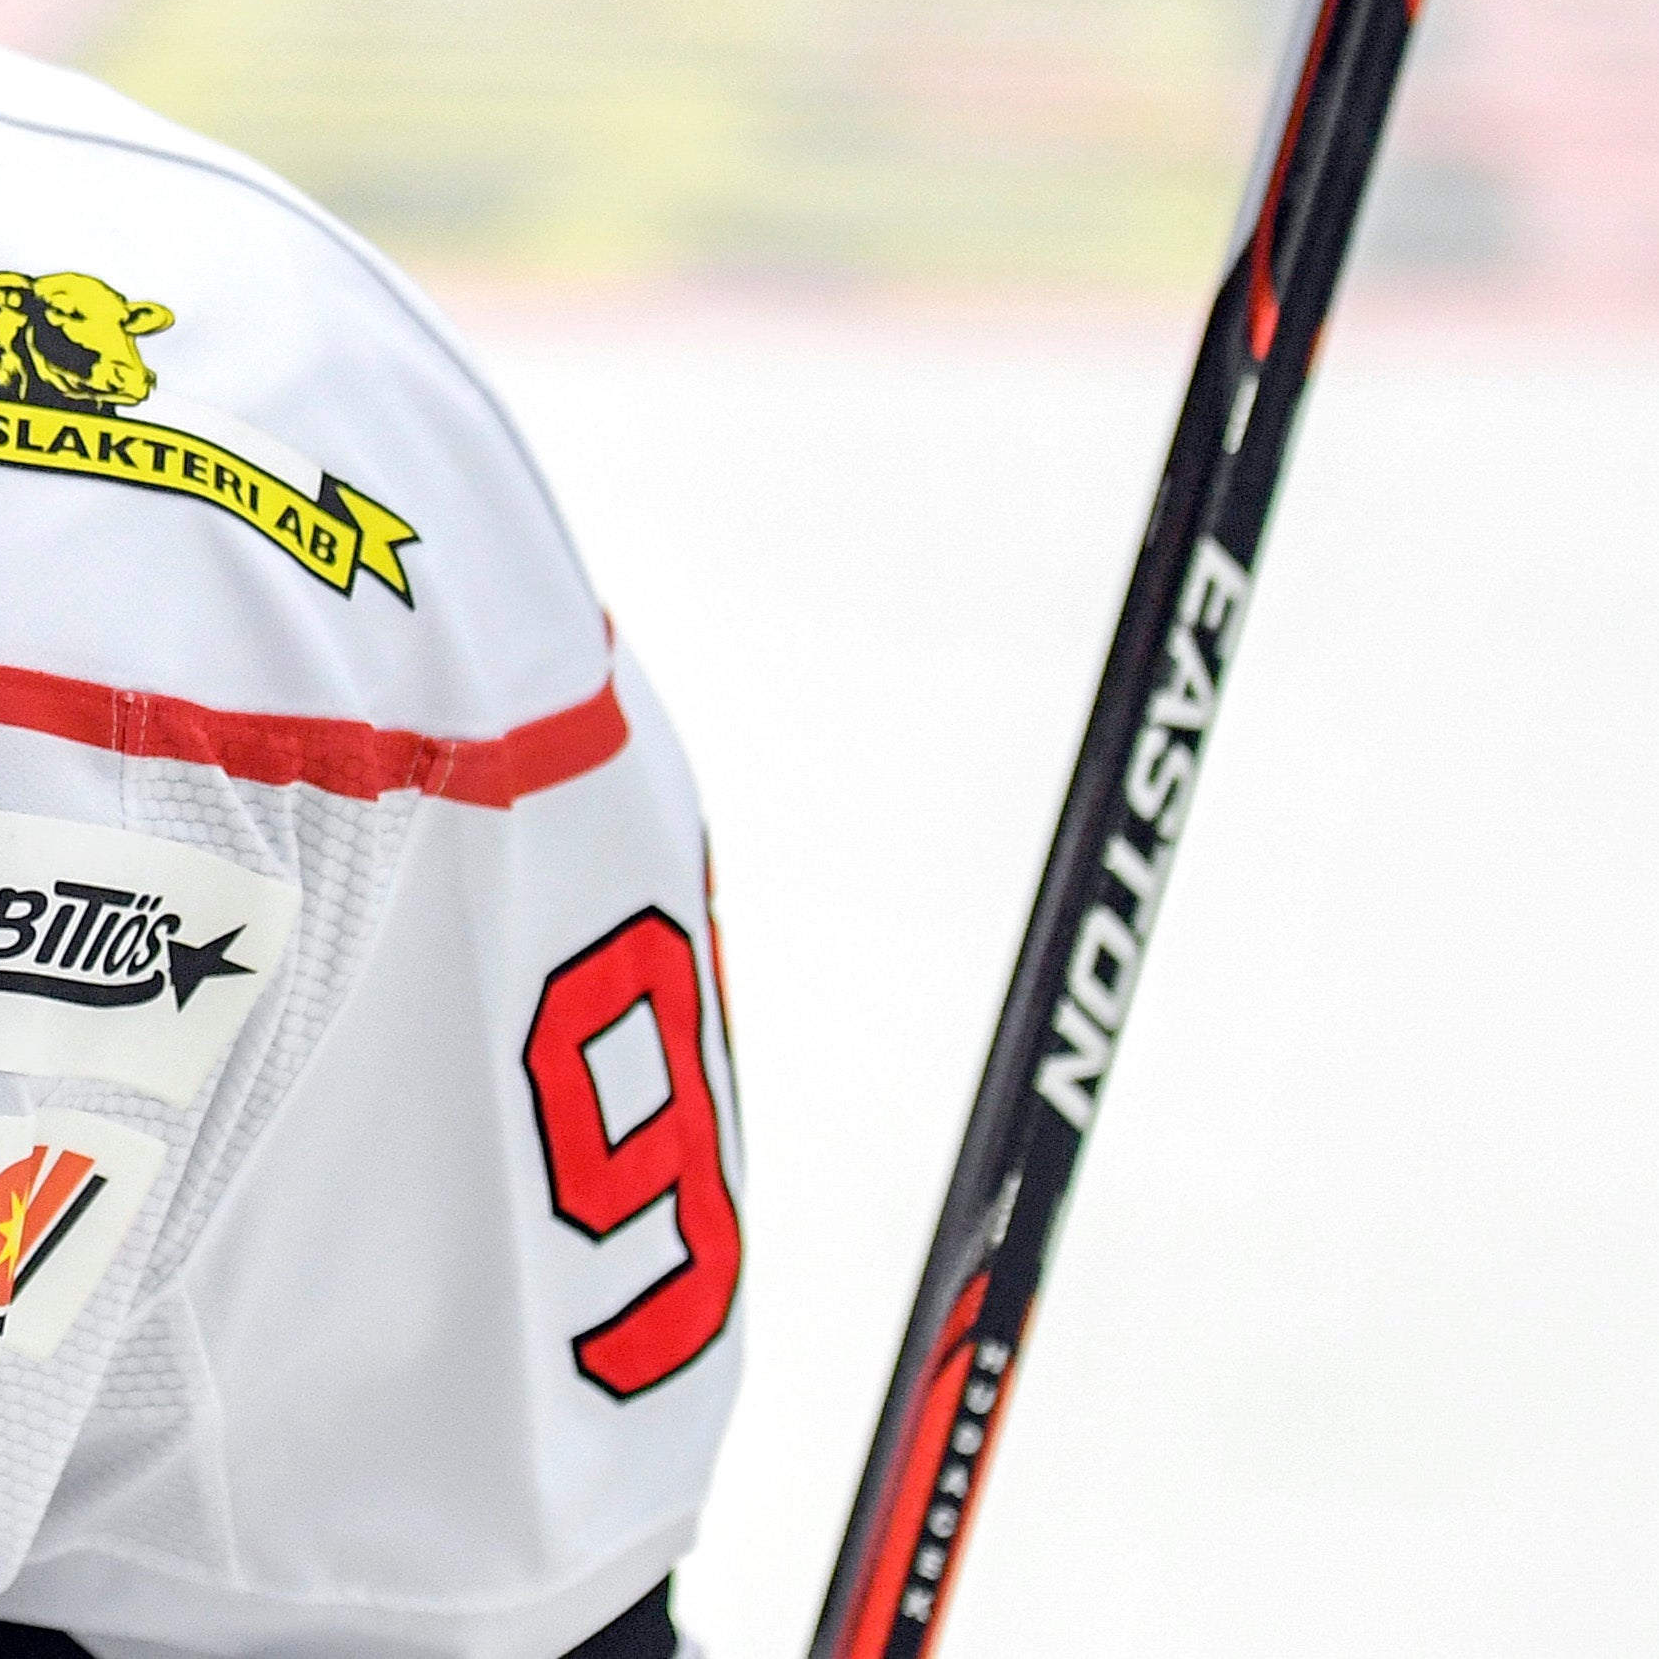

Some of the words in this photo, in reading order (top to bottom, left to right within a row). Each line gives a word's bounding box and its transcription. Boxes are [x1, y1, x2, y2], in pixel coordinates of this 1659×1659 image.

[273, 505, 339, 569] AB
[521, 825, 743, 1406] 9
[1033, 535, 1255, 1136] EASTON
